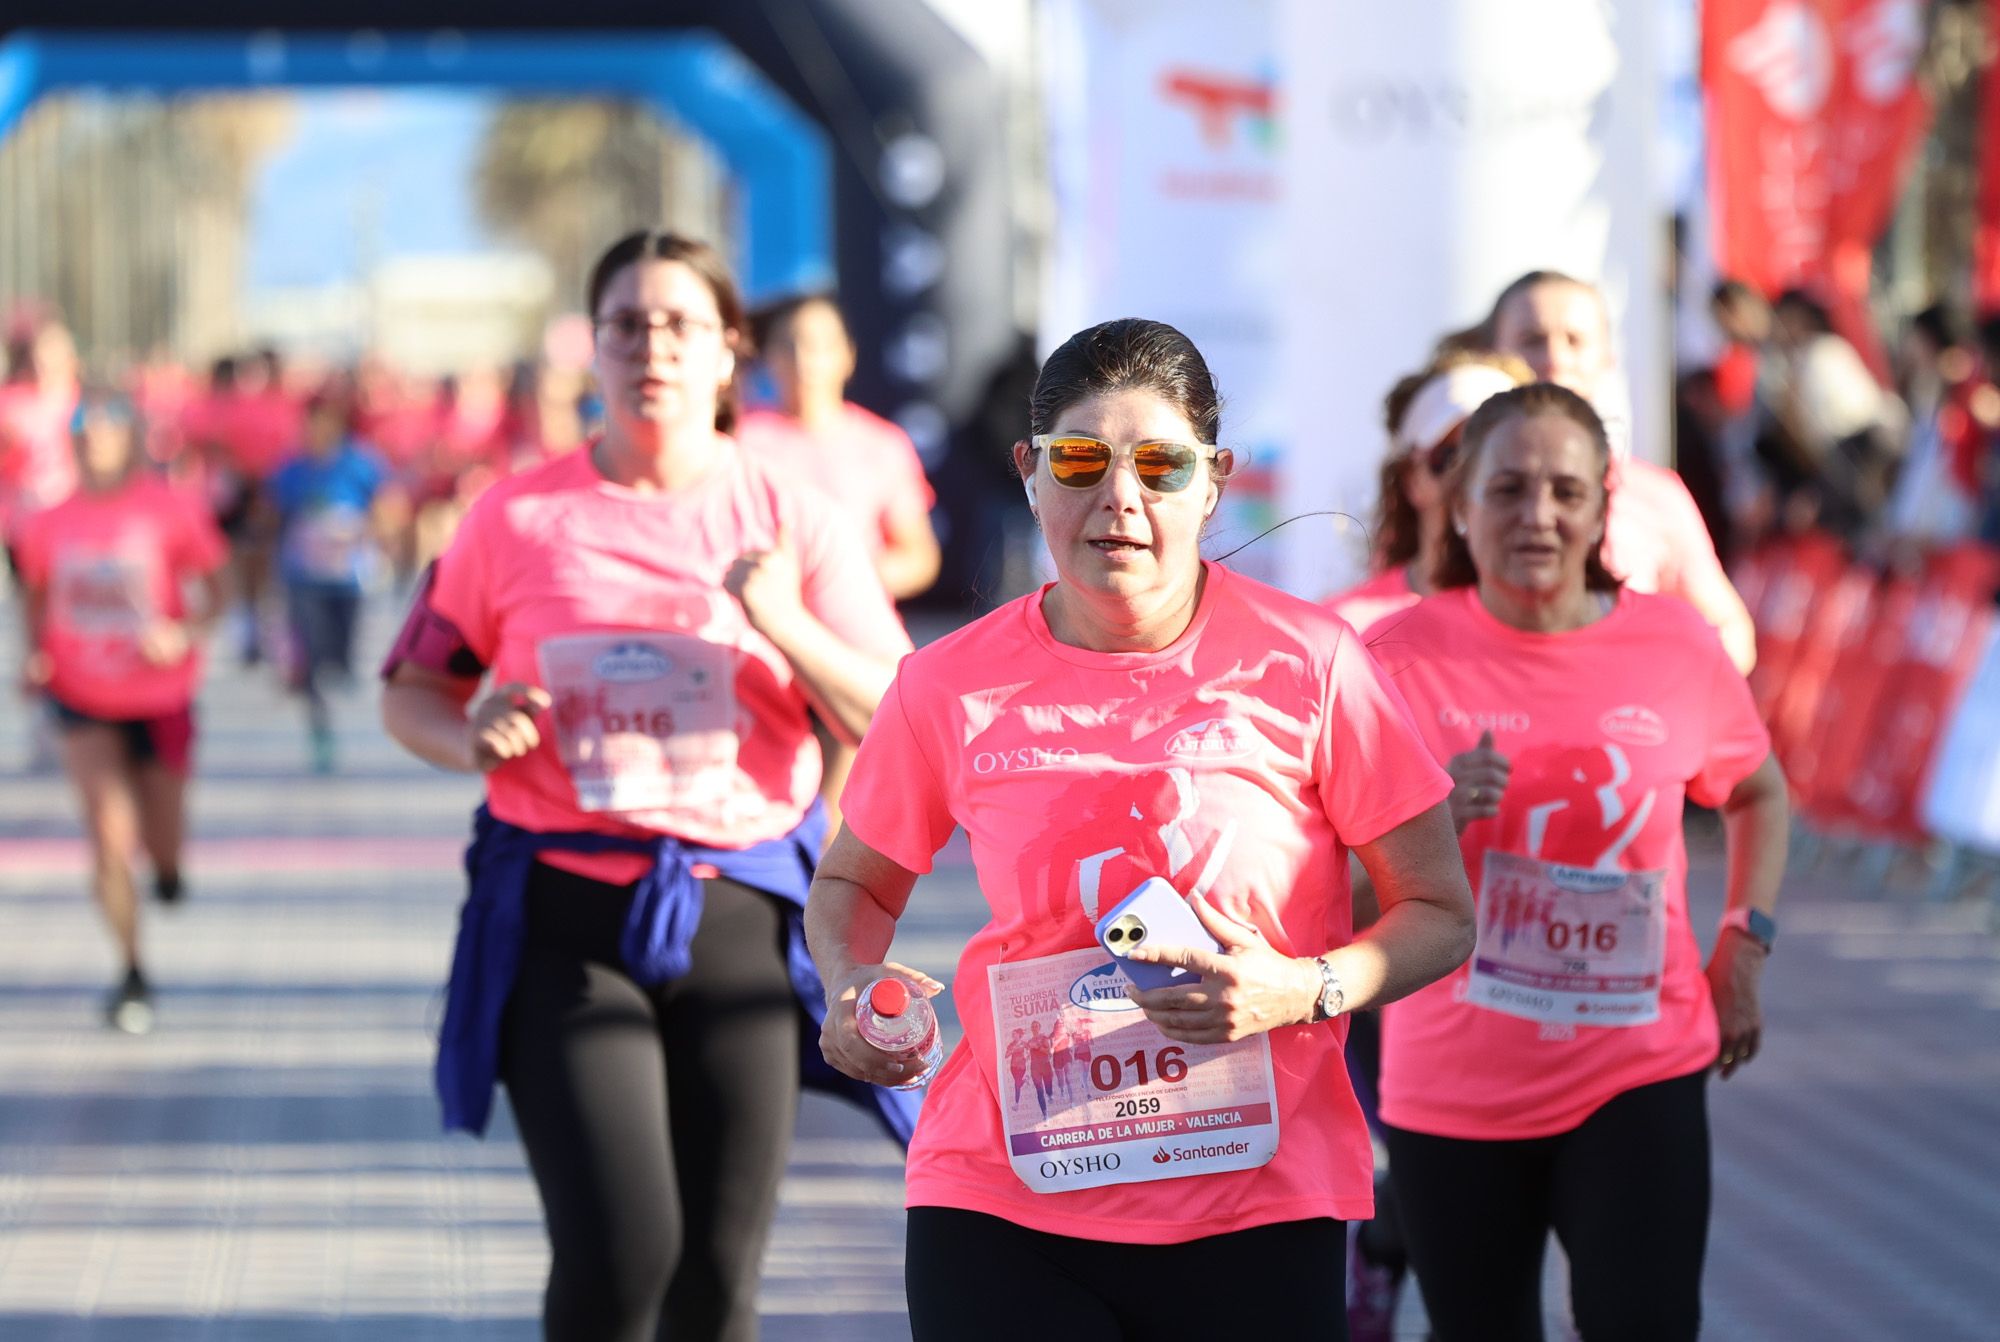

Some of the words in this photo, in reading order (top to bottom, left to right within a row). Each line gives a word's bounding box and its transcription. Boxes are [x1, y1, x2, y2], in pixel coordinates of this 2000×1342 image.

[602, 706, 673, 739] 016
[973, 746, 1080, 775] OYSHO
[1546, 921, 1618, 953] 016
[1079, 984, 1130, 1004] ASTU
[1092, 977, 1128, 986] CENTRAL
[1010, 996, 1022, 1005] TU
[1024, 989, 1058, 1003] DORSAL
[1013, 998, 1060, 1018] SUMA
[1090, 1046, 1188, 1092] 016
[1114, 1097, 1161, 1118] 2059
[1040, 1129, 1096, 1148] CARRERA
[1098, 1127, 1113, 1140] DE
[1117, 1124, 1132, 1138] LA
[1135, 1119, 1176, 1136] MUJER
[1185, 1111, 1243, 1129] VALENCIA
[1040, 1152, 1121, 1179] OYSHO
[1173, 1141, 1250, 1162] Santander
